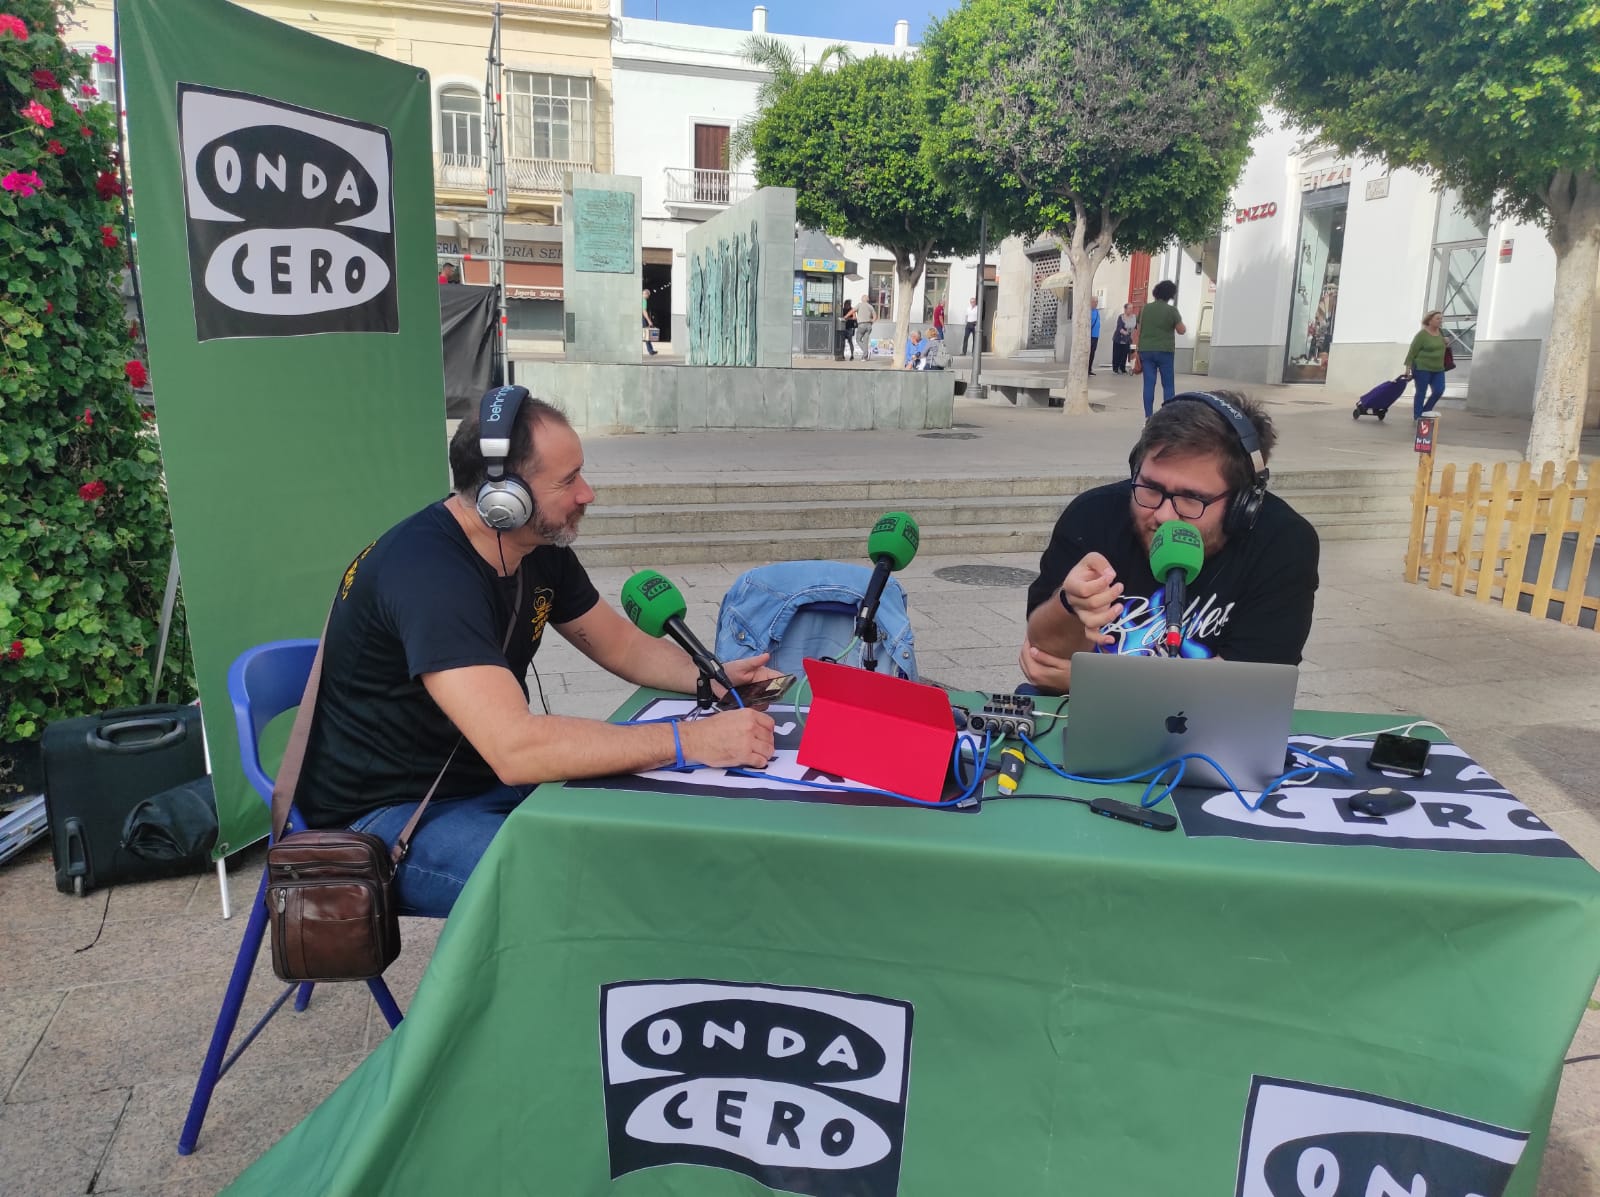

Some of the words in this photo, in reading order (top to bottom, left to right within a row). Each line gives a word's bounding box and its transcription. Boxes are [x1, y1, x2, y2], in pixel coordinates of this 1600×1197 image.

[214, 145, 361, 207] ONDA
[232, 242, 366, 295] CERO
[647, 1018, 859, 1071] ONDA
[663, 1090, 855, 1157] CERO
